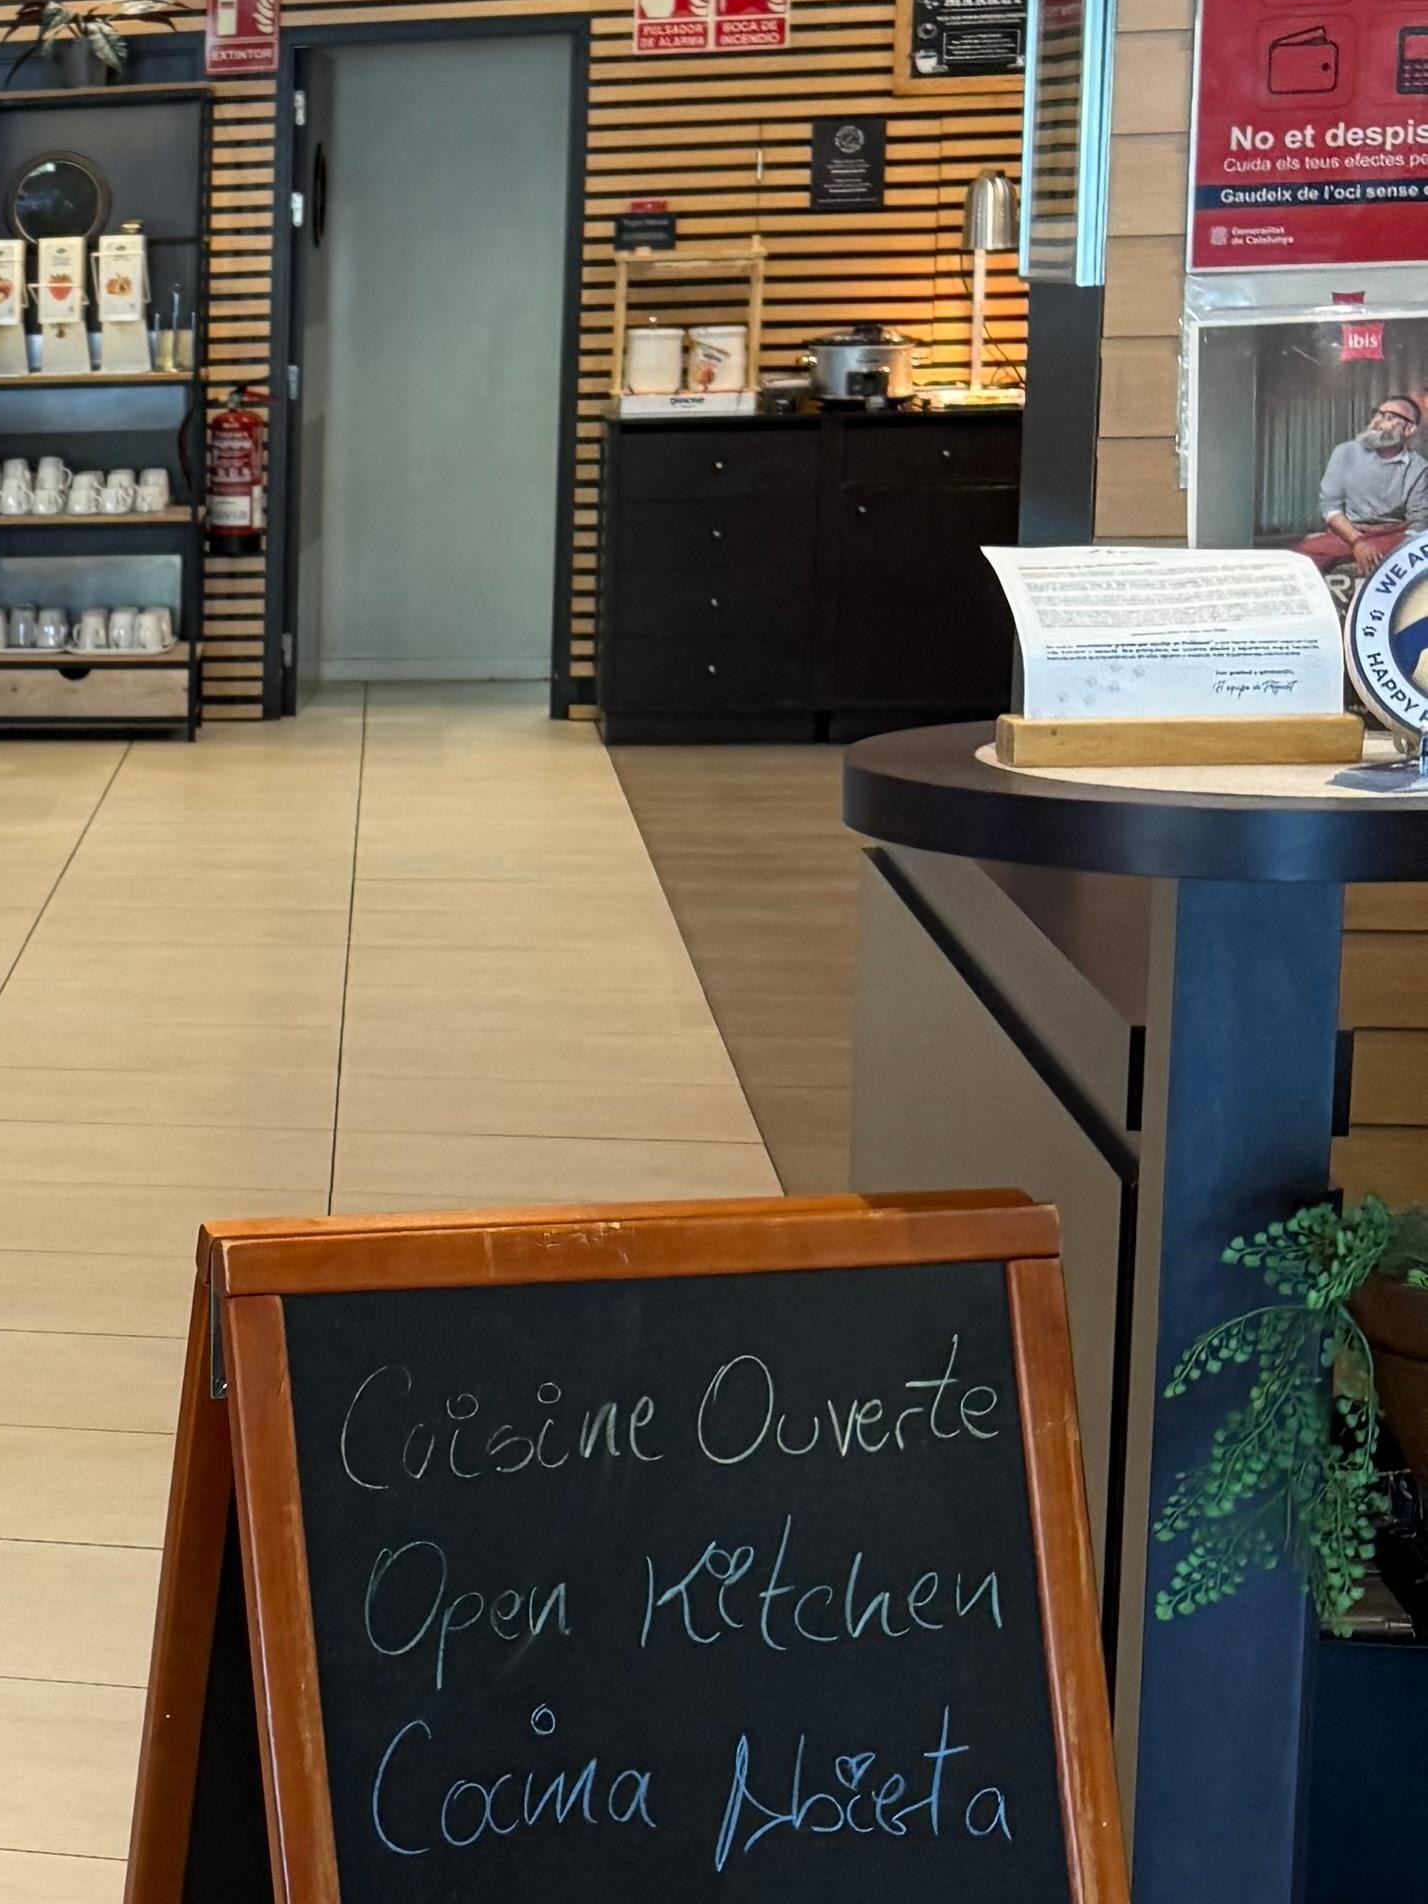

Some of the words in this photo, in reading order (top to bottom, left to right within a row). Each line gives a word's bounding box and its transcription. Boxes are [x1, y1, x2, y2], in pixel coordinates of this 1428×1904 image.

[722, 21, 759, 33] BOCA
[760, 20, 778, 31] DE
[211, 48, 273, 61] EXTINTOR
[1230, 125, 1275, 151] No
[1284, 124, 1316, 149] et
[1325, 119, 1428, 151] despis
[1224, 157, 1272, 173] Cuida
[1276, 155, 1300, 171] els
[1344, 152, 1406, 169] efectes
[1220, 188, 1293, 204] Gaudeix
[1297, 187, 1319, 201] de
[1324, 184, 1361, 200] l'oci
[1366, 186, 1419, 199] sense
[1348, 332, 1379, 349] ibis
[1376, 563, 1407, 597] WE
[1367, 651, 1420, 713] HAPPY
[341, 1364, 663, 1492] Cuisine
[696, 1335, 1000, 1466] Ouverte
[364, 1539, 571, 1689] Open
[639, 1514, 1003, 1653] Kitchen
[373, 1704, 657, 1855] Cocina
